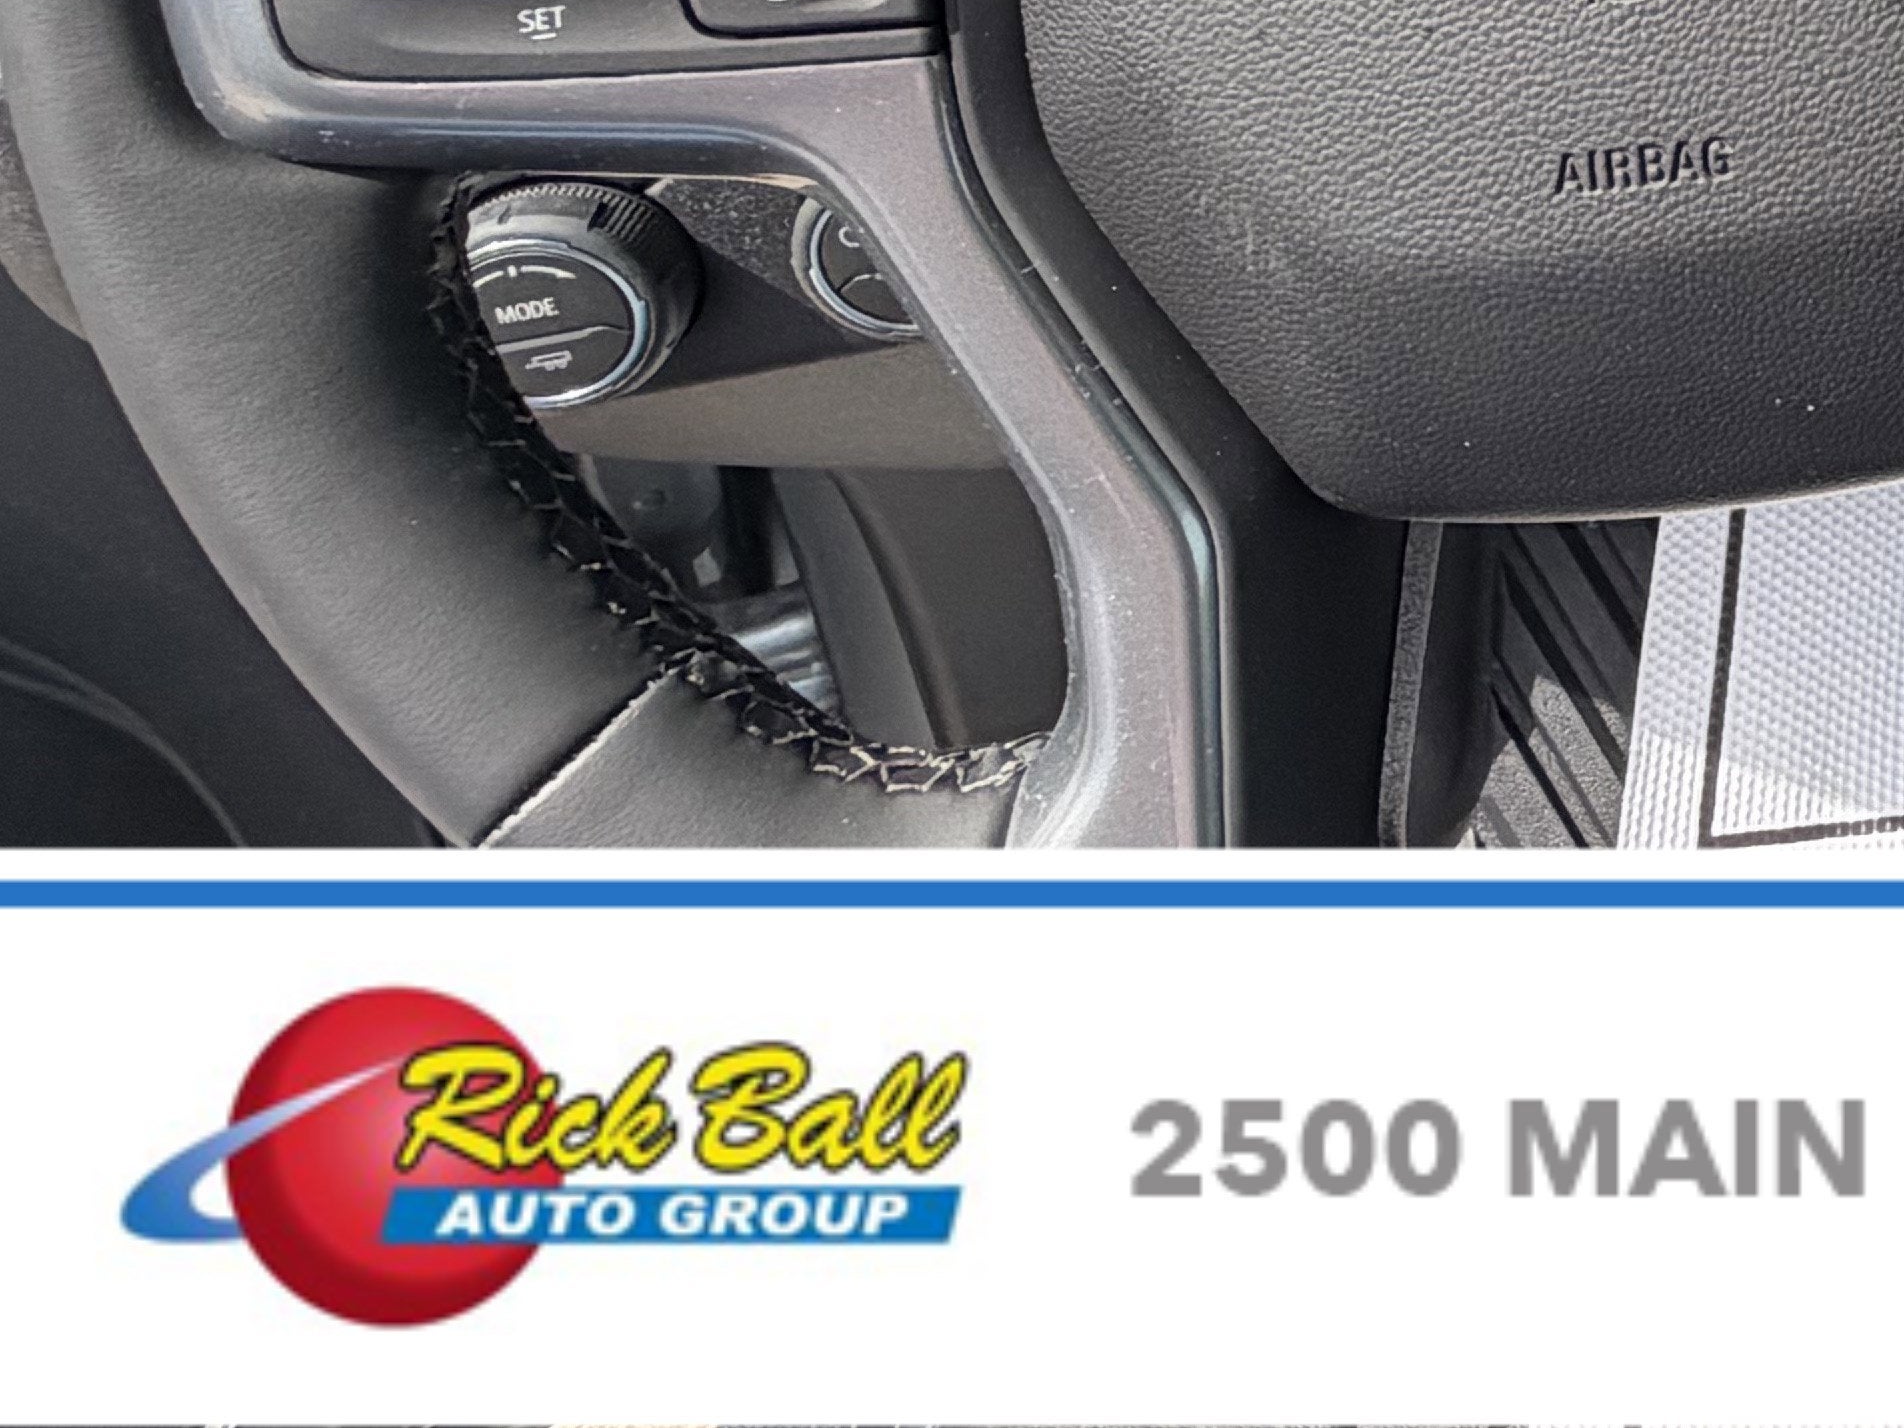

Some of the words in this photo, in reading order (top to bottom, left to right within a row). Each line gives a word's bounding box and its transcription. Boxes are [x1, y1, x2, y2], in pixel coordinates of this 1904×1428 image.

[518, 5, 566, 34] SET
[1553, 138, 1734, 195] AIRBAG
[494, 296, 560, 326] MODE
